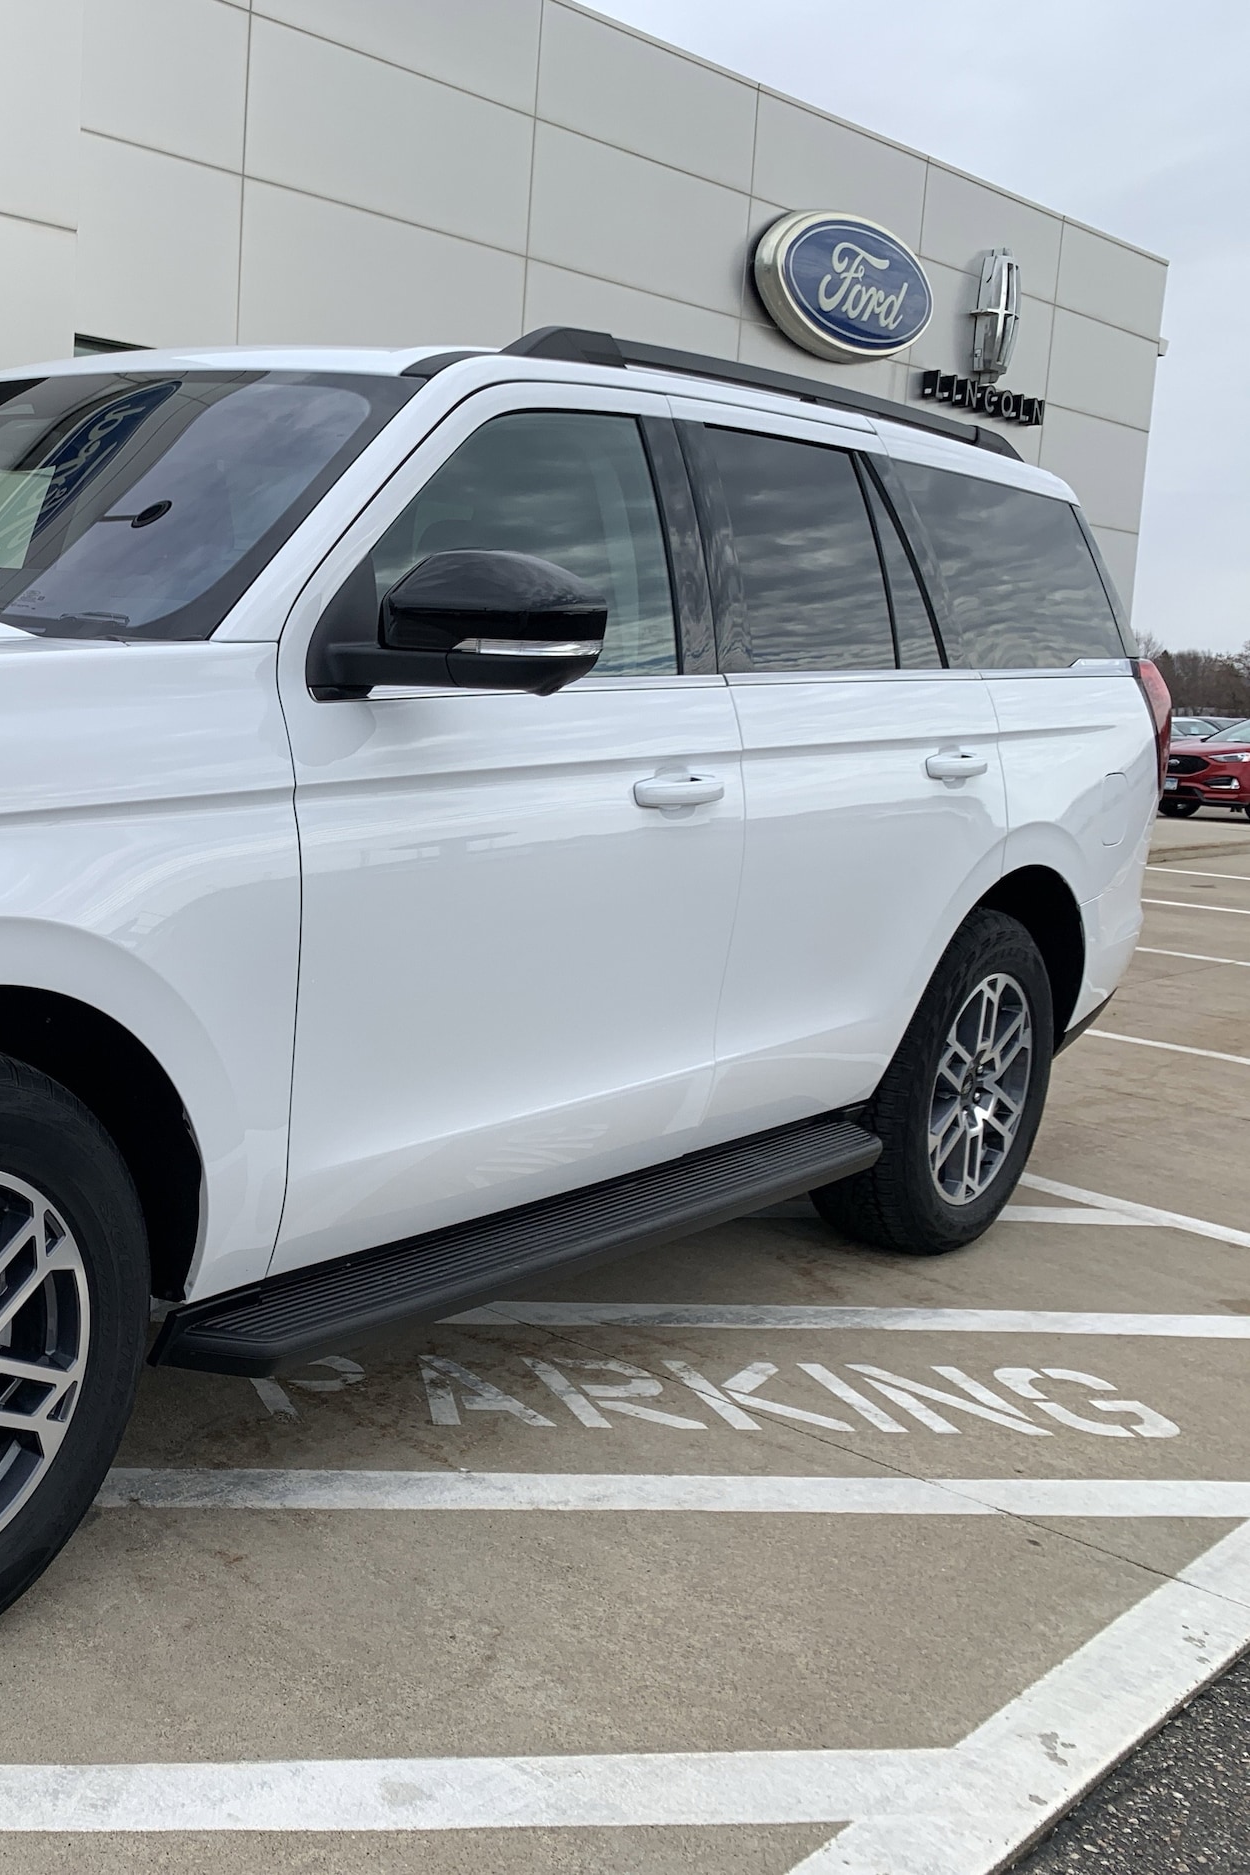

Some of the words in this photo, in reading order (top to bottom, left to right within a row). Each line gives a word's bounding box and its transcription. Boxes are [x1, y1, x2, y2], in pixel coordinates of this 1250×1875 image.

[819, 242, 908, 330] Ford
[922, 370, 1046, 426] LINCOLN
[250, 1354, 1181, 1440] PARKING
